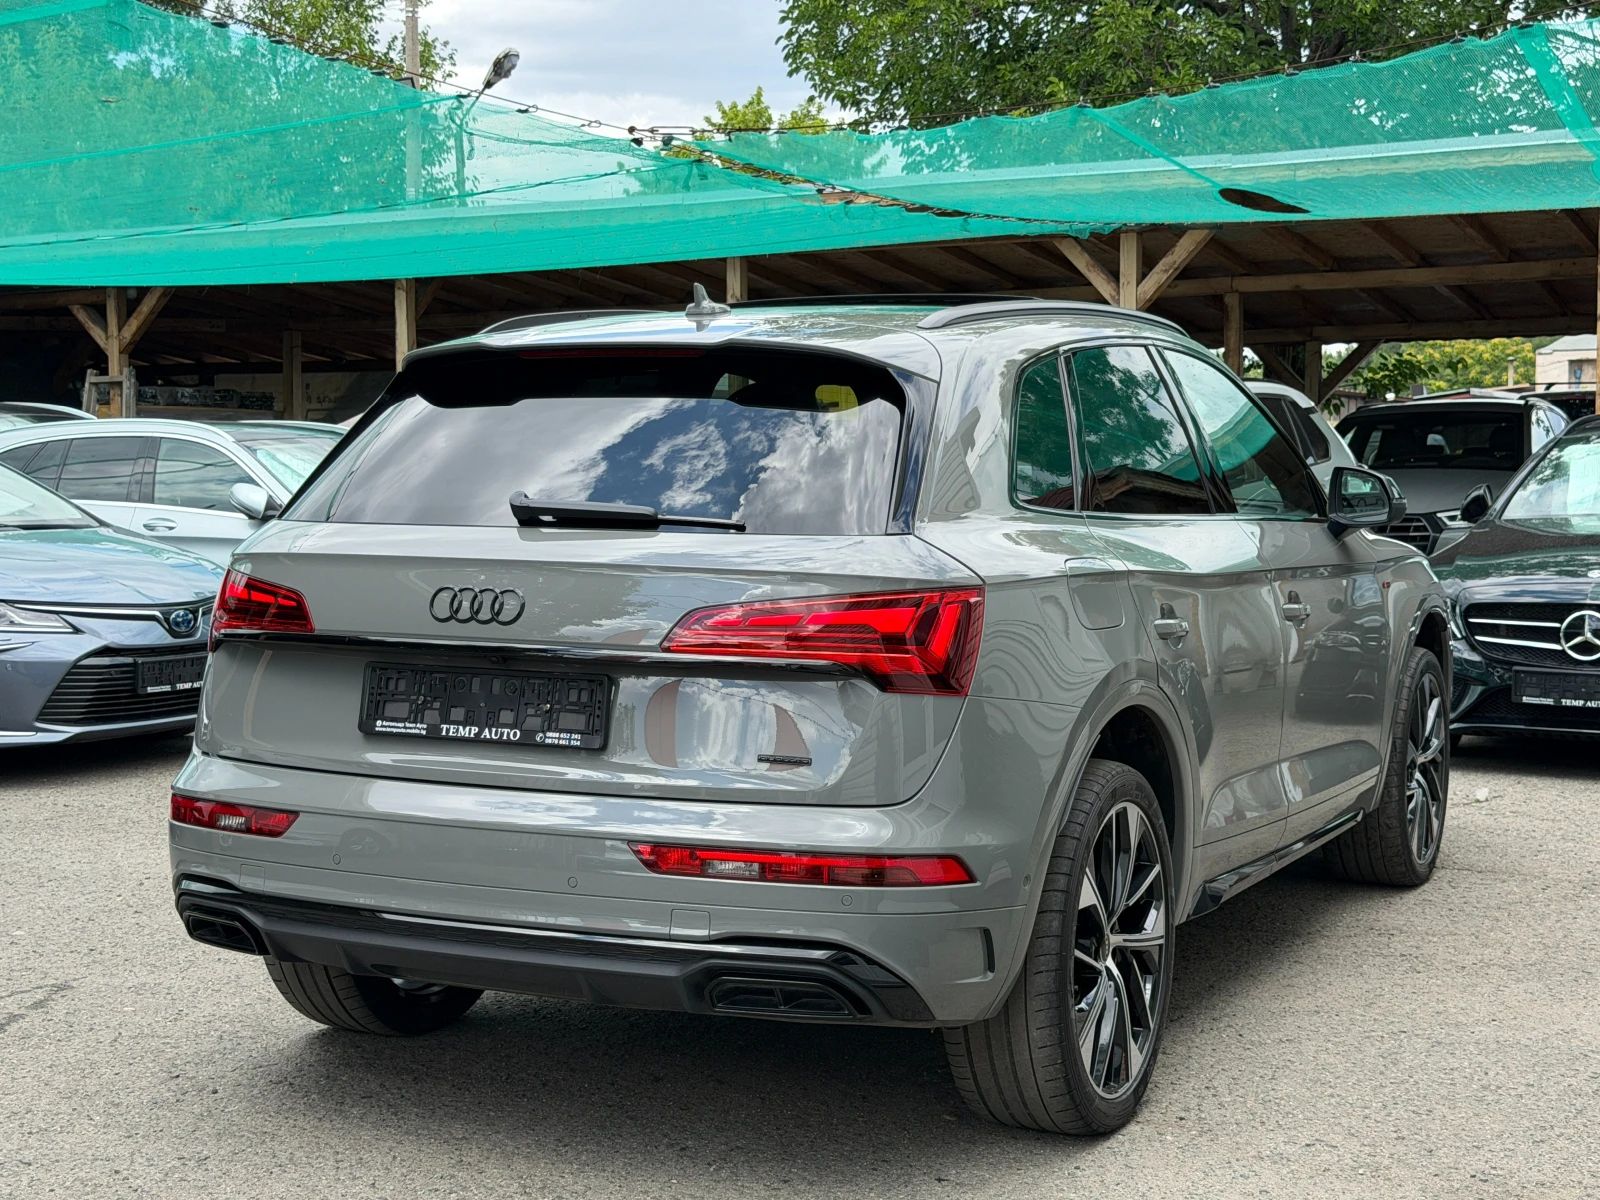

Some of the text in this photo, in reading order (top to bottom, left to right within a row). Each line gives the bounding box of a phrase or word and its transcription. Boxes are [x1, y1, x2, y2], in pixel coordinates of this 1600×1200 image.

[176, 682, 192, 690] TEMP
[441, 724, 521, 741] TEMP AUTO
